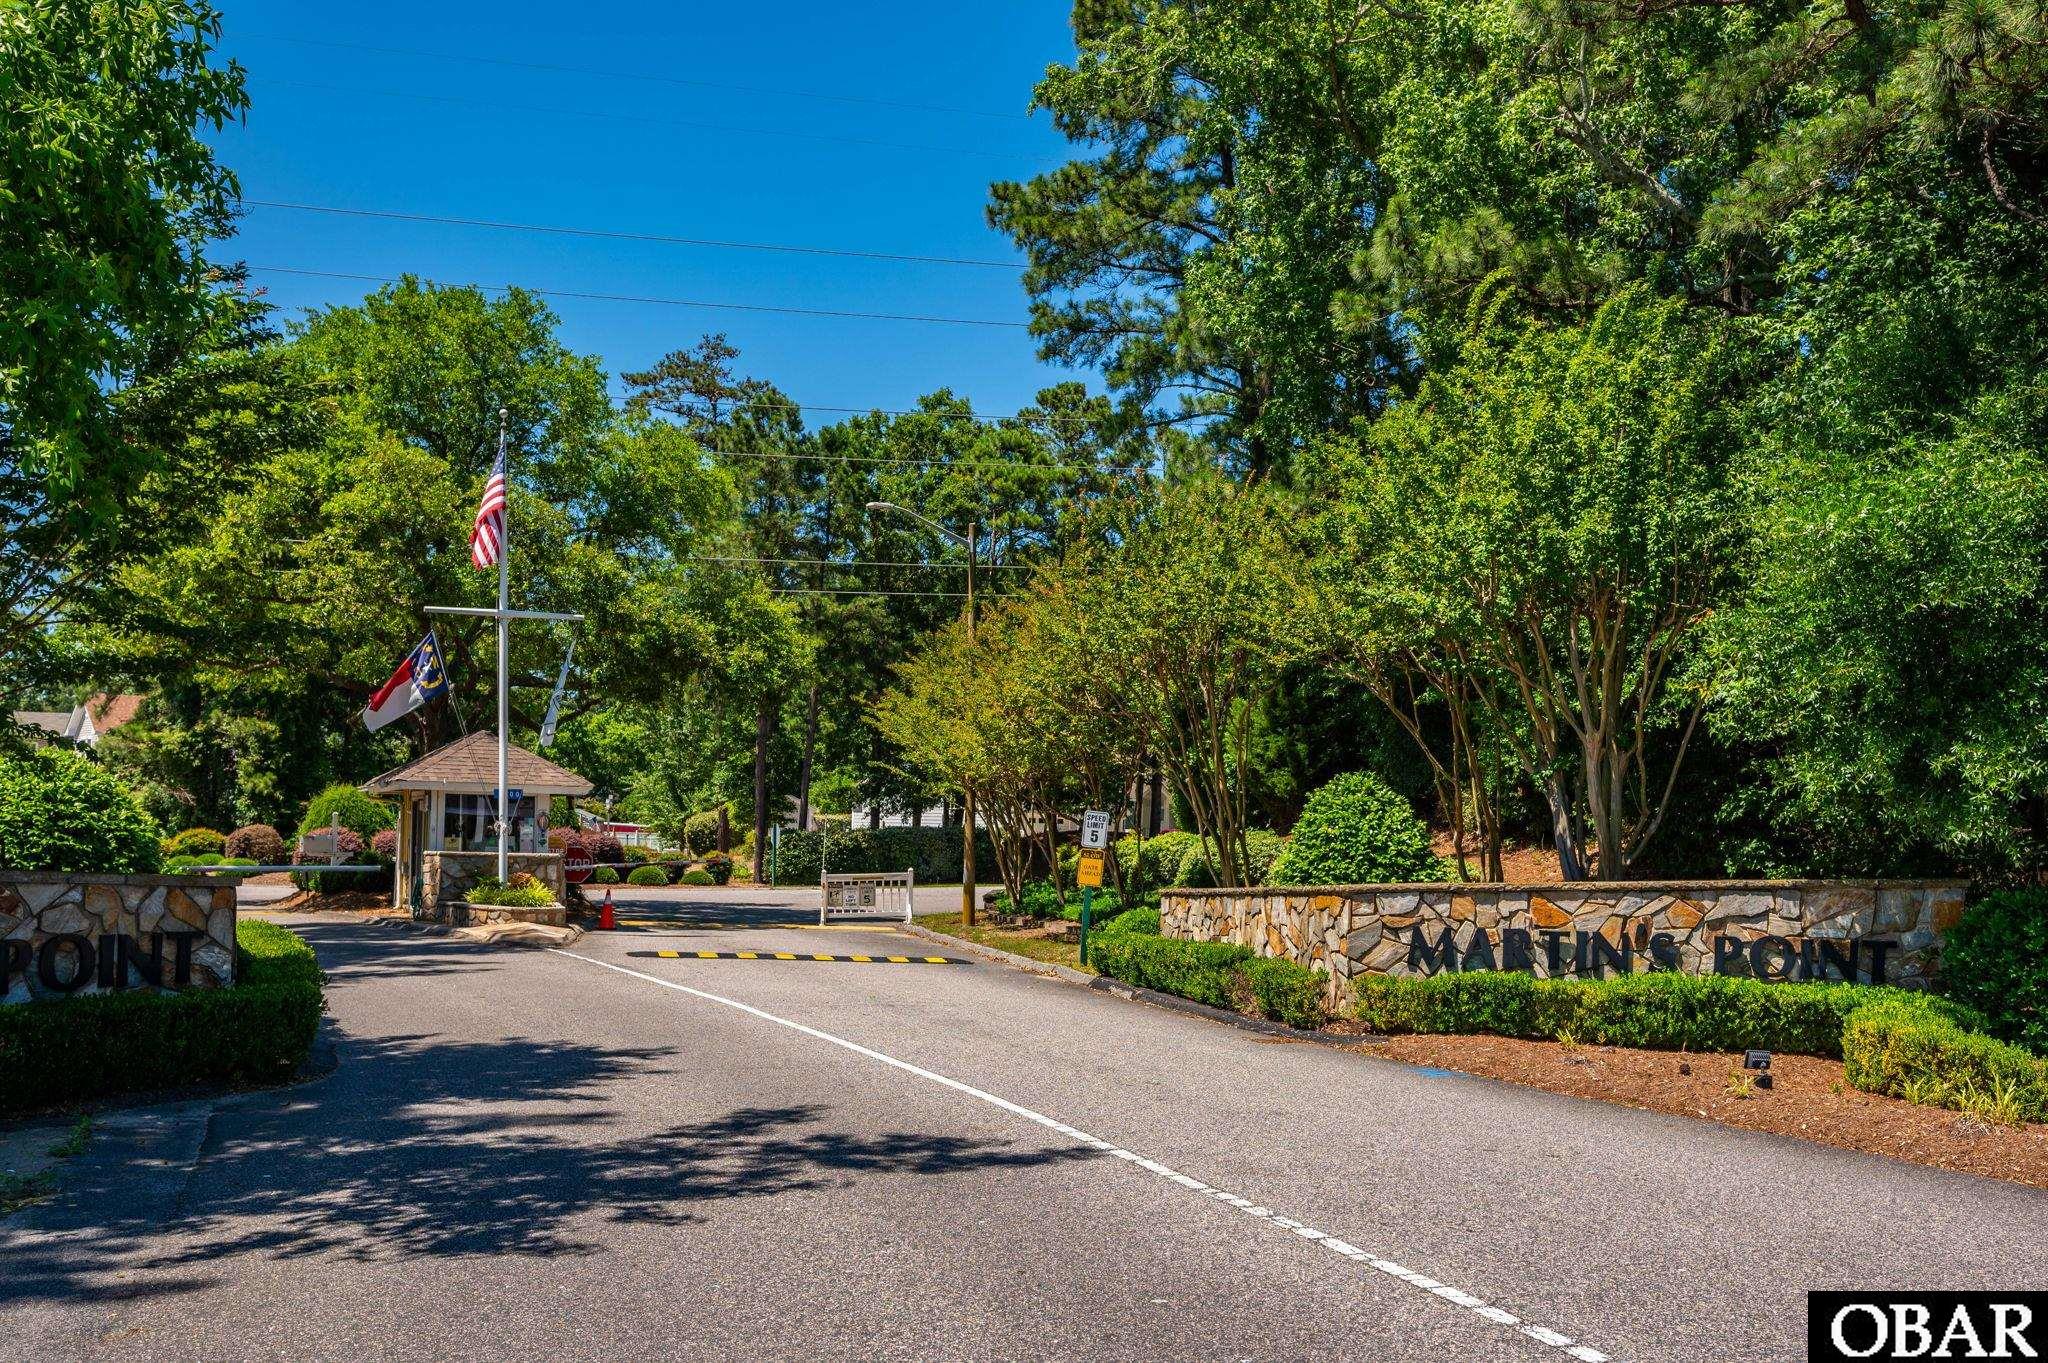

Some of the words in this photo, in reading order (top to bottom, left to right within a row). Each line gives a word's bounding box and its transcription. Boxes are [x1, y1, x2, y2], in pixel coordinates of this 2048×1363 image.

[1087, 814, 1106, 822] SPEED
[1087, 821, 1105, 829] LIMIT
[1090, 830, 1098, 842] 5
[567, 858, 590, 871] TOP
[1408, 924, 1682, 976] MARTIN'S
[1714, 935, 1898, 985] POINT
[0, 931, 203, 995] POINT
